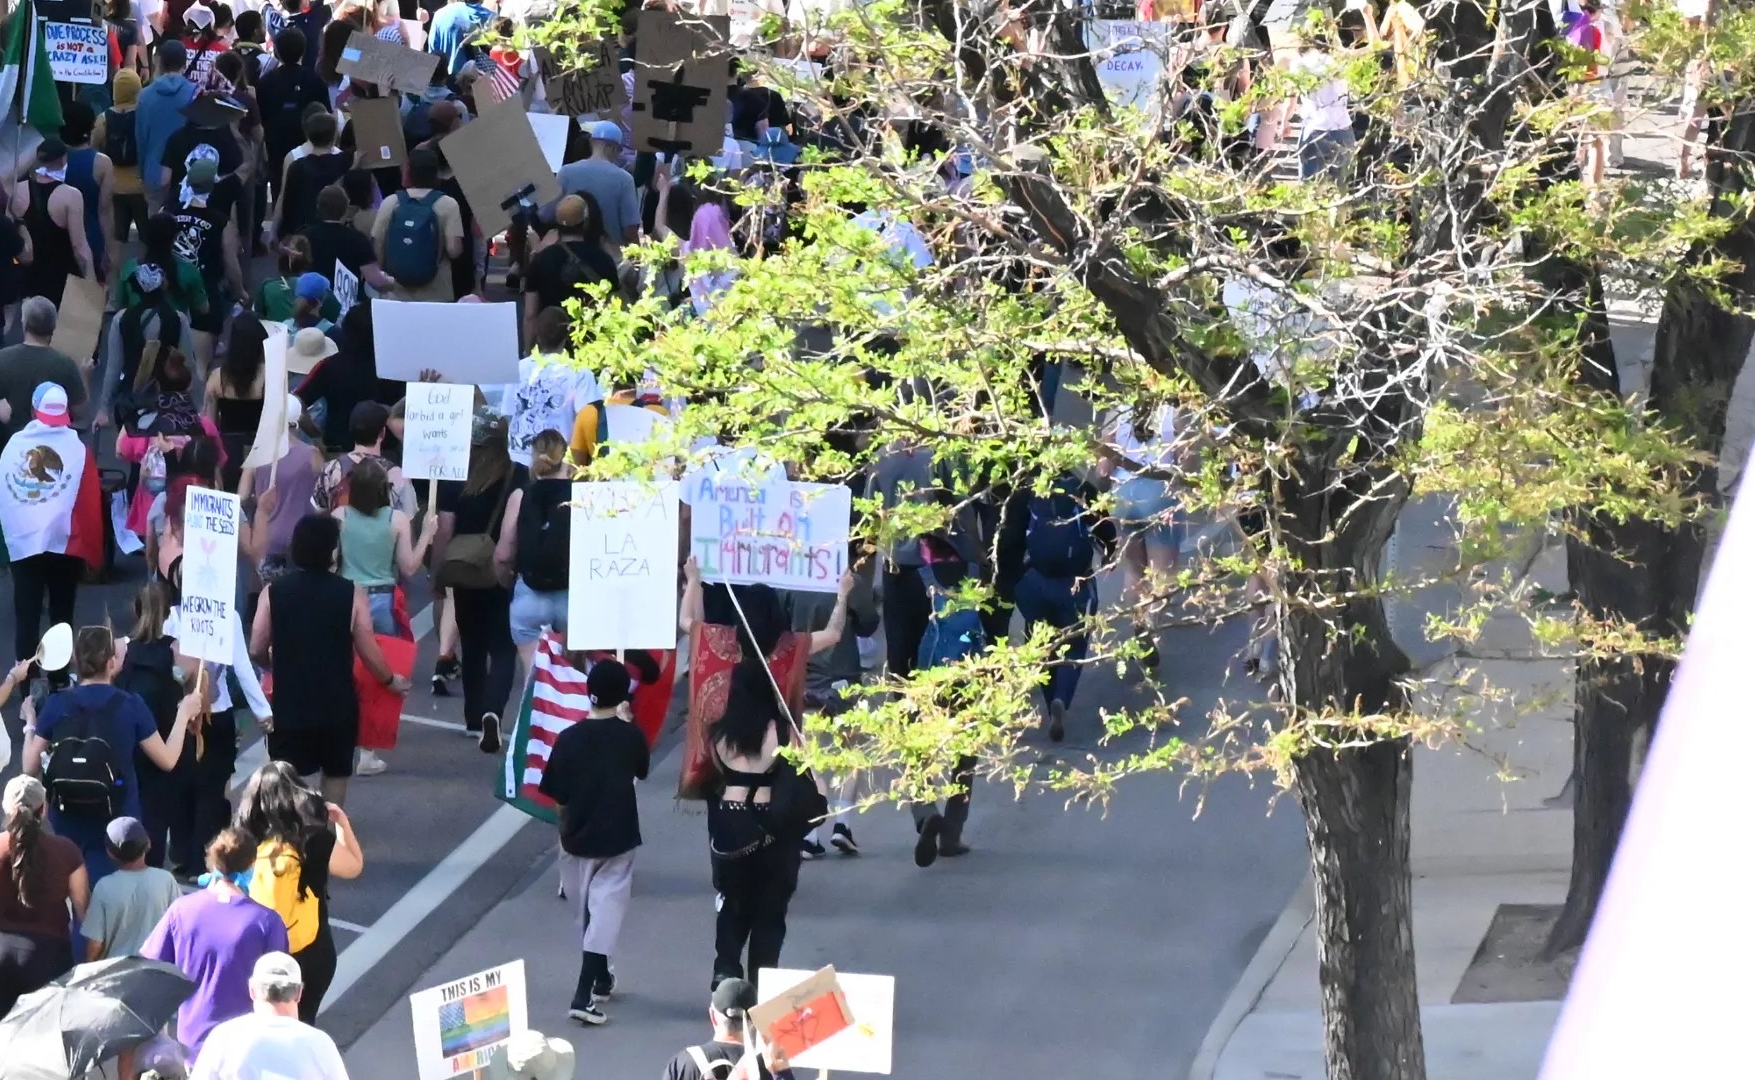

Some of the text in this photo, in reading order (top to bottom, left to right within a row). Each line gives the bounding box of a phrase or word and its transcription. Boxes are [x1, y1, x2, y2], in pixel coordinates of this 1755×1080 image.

[46, 24, 107, 47] DUE PROCESS
[66, 42, 84, 53] NOT
[604, 532, 637, 555] LA
[589, 557, 651, 581] RAZA
[441, 971, 503, 1003] THIS IS MY
